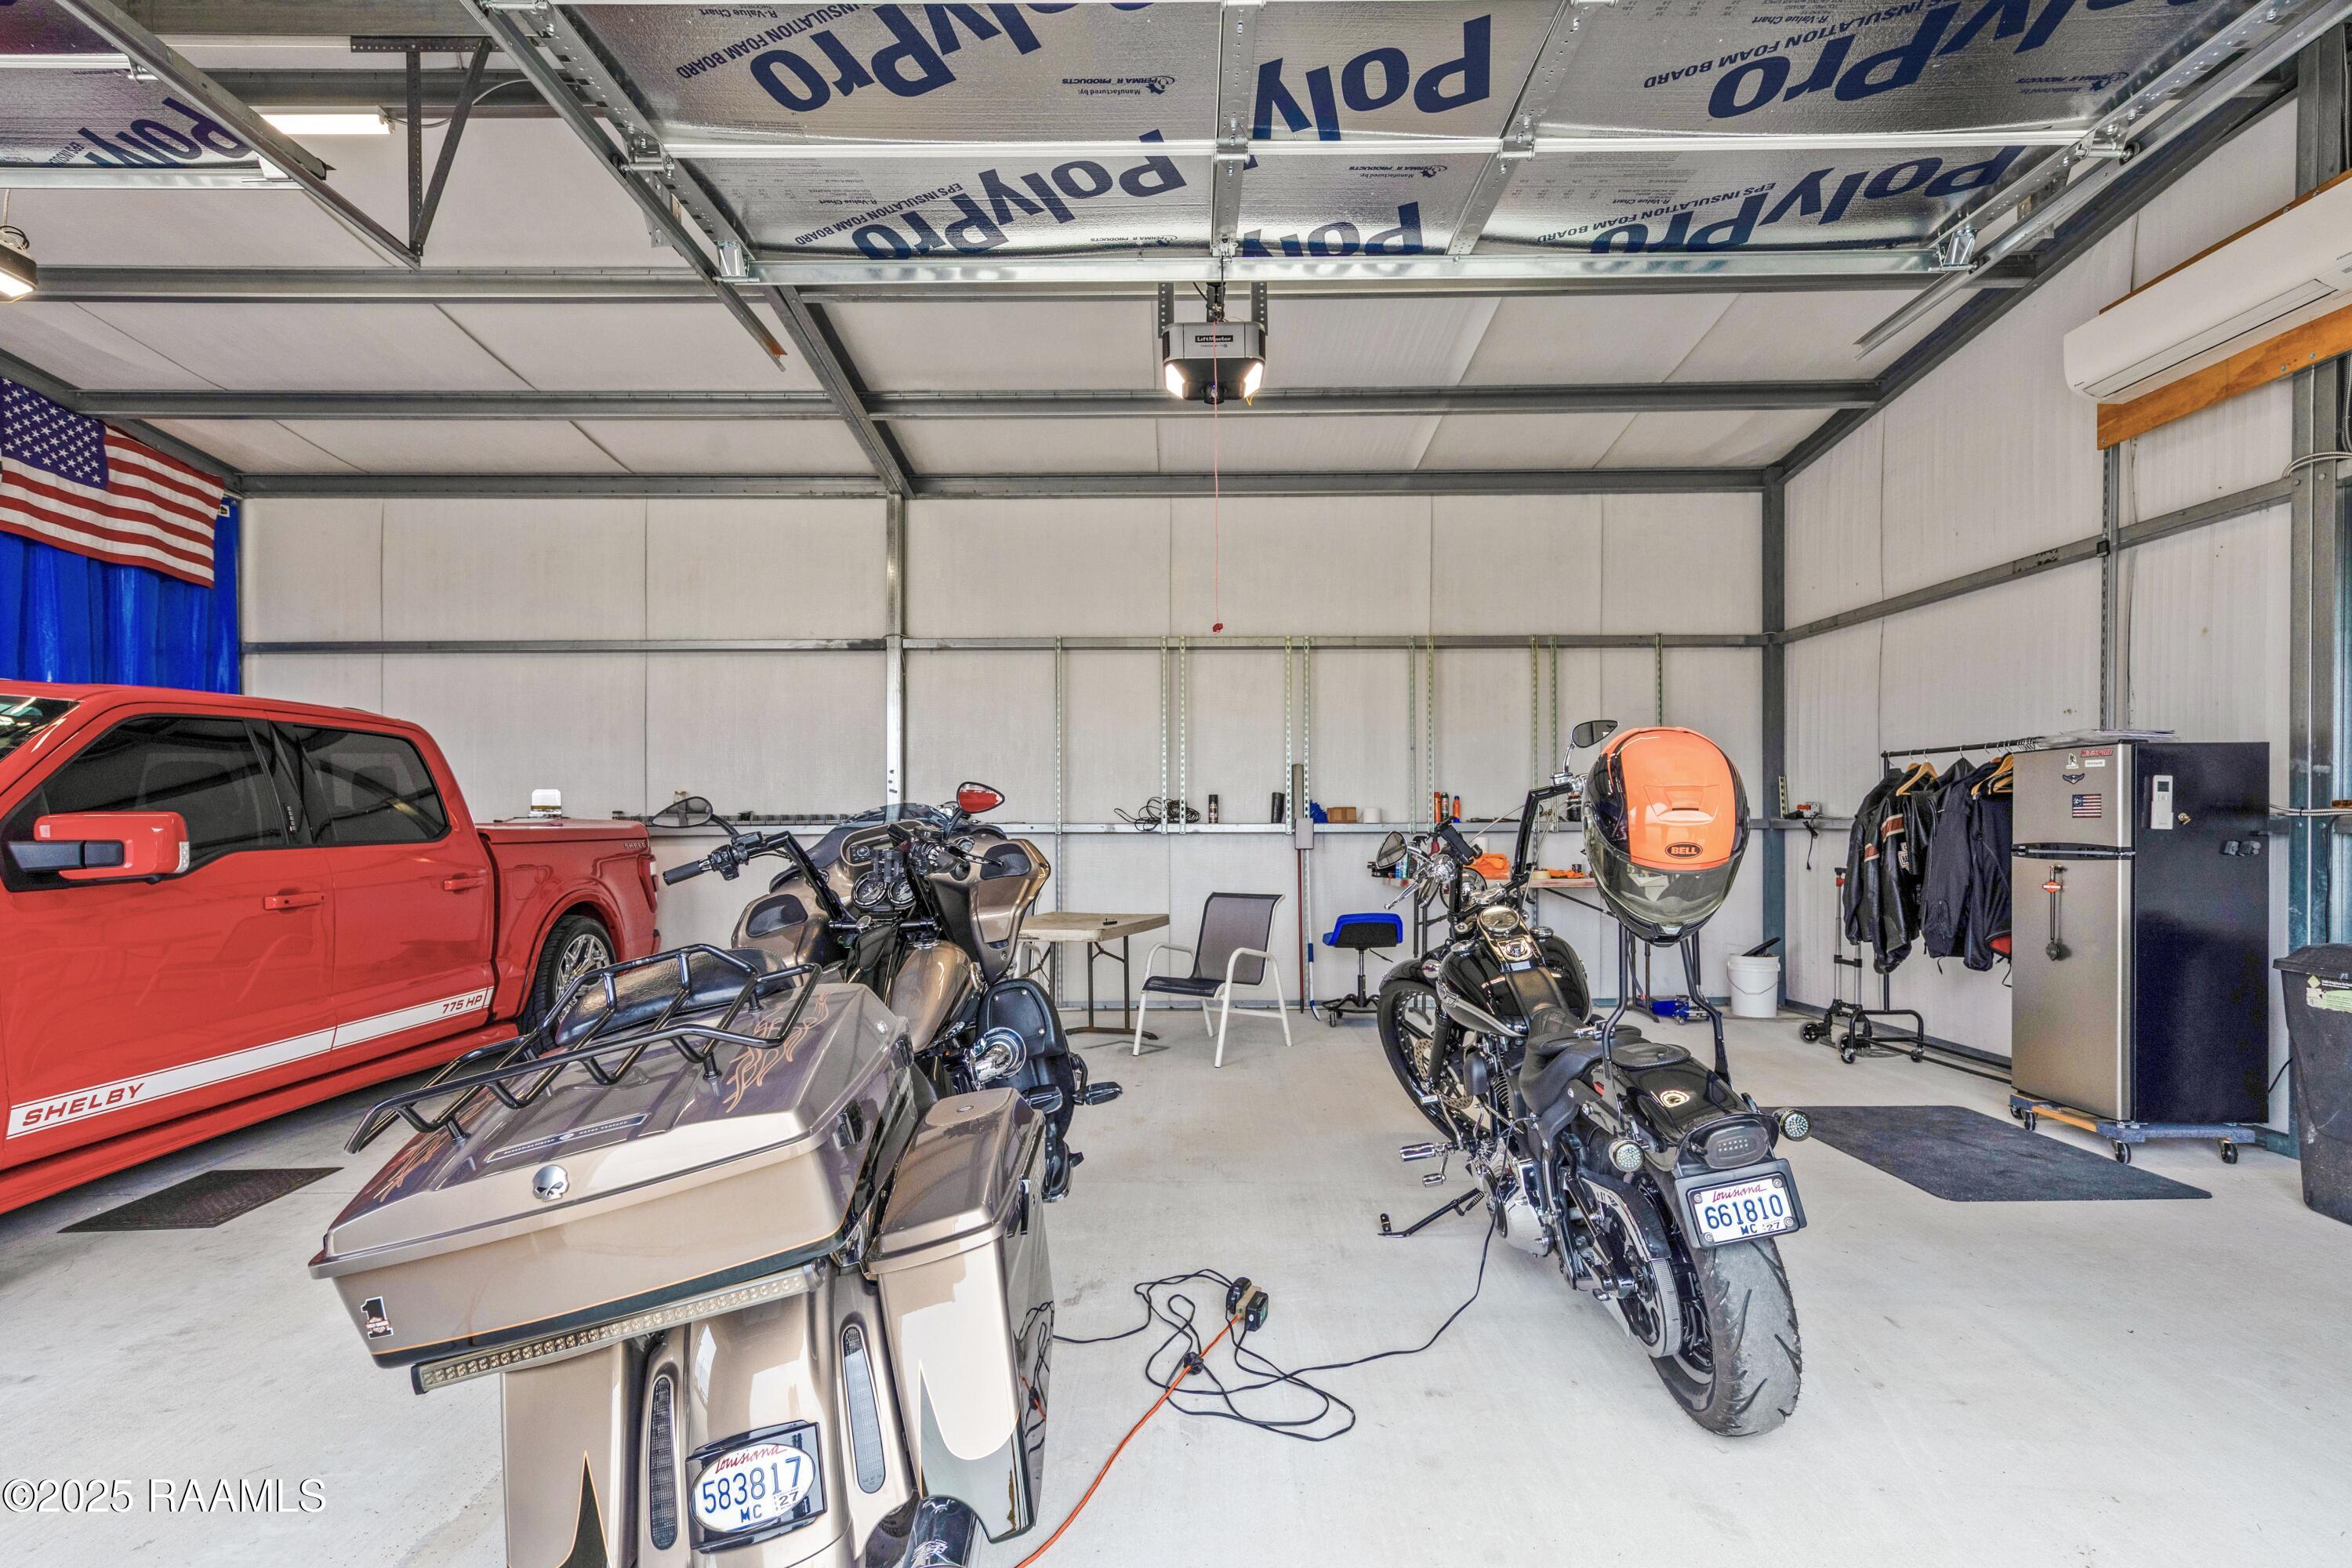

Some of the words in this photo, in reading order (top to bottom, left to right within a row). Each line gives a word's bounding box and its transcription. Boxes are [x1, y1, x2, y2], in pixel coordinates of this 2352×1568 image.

[699, 8, 732, 18] Chart
[733, 7, 778, 19] R-Value
[1752, 15, 1784, 24] Chart
[1784, 15, 1829, 24] R-Value
[723, 33, 769, 60] FOAM
[1719, 40, 1781, 68] FOAM
[676, 51, 724, 80] BOARD
[750, 4, 1156, 112] lyPro
[1708, 0, 2197, 118] lyPro
[1126, 77, 1158, 85] PERMA
[1643, 60, 1715, 89] BOARD
[851, 129, 1186, 260] PolyPro
[937, 183, 964, 198] EPS
[1743, 182, 1777, 194] EPS
[866, 191, 938, 221] INSULATION
[1640, 191, 1741, 220] INSULATION
[832, 212, 868, 232] FOAM
[1592, 213, 1638, 231] FOAM
[794, 225, 833, 246] BOARD
[1537, 225, 1589, 244] BOARD
[1671, 846, 1697, 855] BELL
[442, 999, 465, 1014] 775
[466, 994, 483, 1007] HP
[22, 1083, 145, 1127] SHELBY
[1712, 1184, 1769, 1203] Louisiana
[1704, 1193, 1784, 1229] 661810
[1740, 1223, 1758, 1236] MC
[1766, 1221, 1781, 1232] 27
[714, 1443, 788, 1475] Louisiana
[702, 1455, 801, 1514] 583817
[739, 1504, 763, 1523] MC
[779, 1490, 799, 1507] 27
